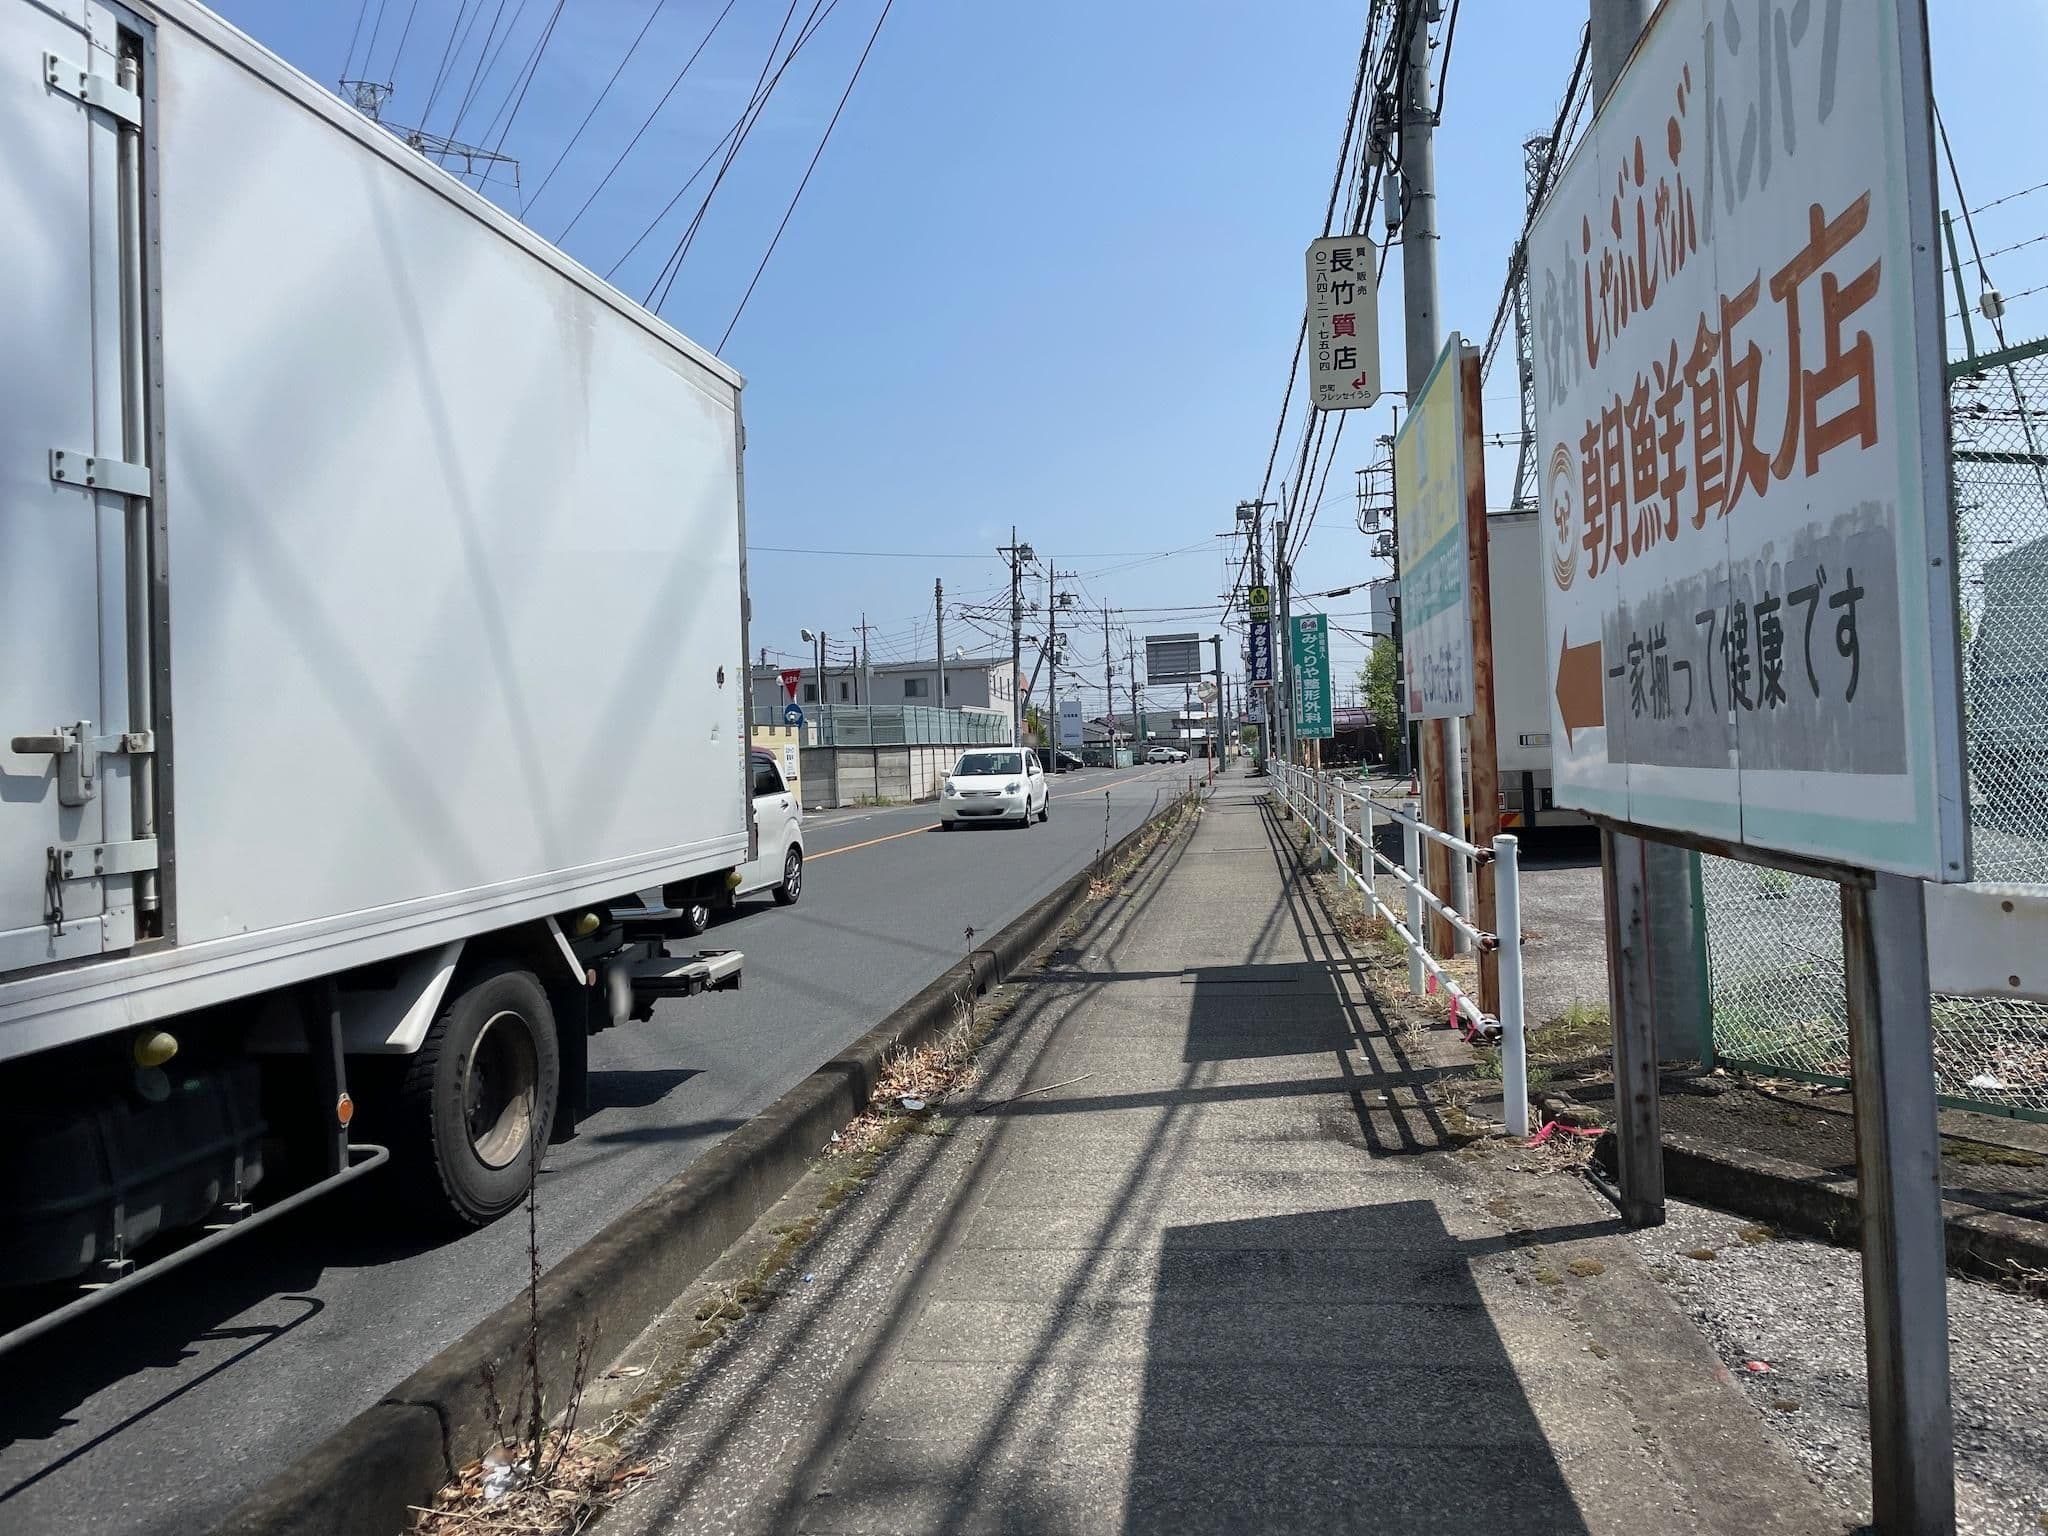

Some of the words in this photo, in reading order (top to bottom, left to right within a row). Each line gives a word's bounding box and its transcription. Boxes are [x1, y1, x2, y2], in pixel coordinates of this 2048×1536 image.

[1330, 248, 1357, 371] 長竹質店
[1579, 188, 1881, 579] 朝鮮飯店
[1301, 633, 1322, 724] みくりや整形外科
[1608, 564, 1864, 720] 一家揃って健康です
